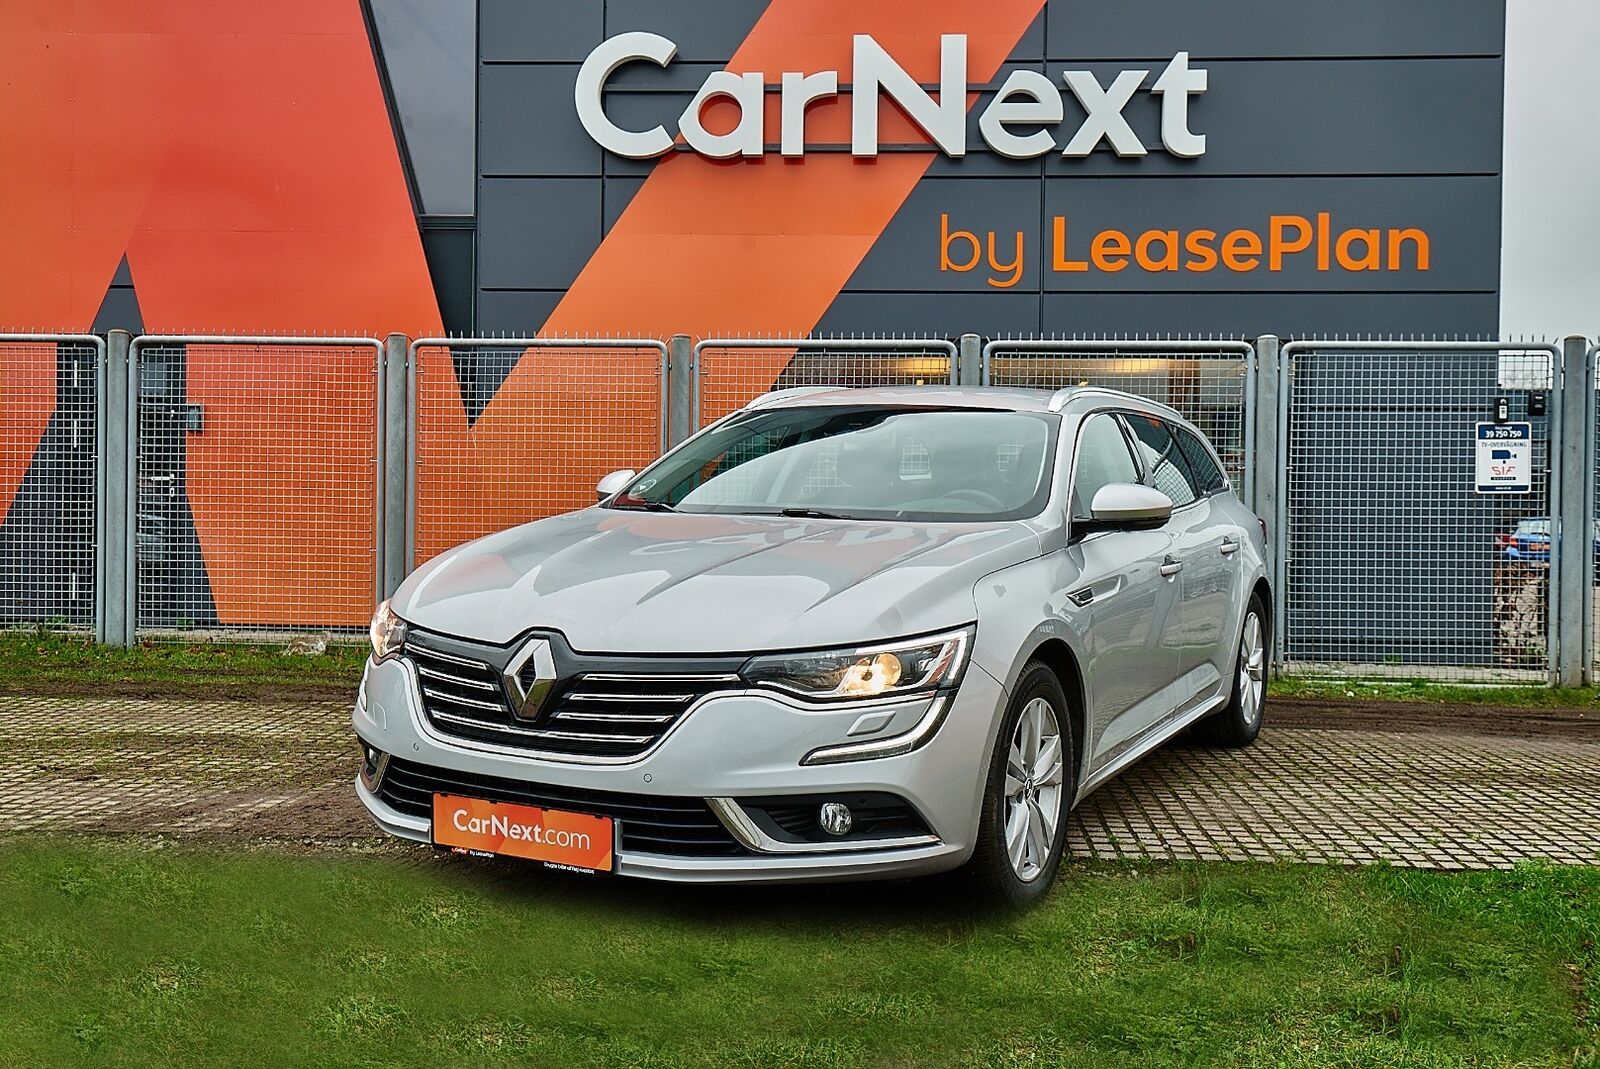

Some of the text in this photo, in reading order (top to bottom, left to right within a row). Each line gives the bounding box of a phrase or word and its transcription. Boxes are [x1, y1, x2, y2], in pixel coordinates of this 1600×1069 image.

[575, 31, 1207, 159] CarNext
[940, 212, 1430, 288] by LeasePlan
[1485, 430, 1522, 438] 39 750 750
[453, 809, 591, 850] CarNext.com
